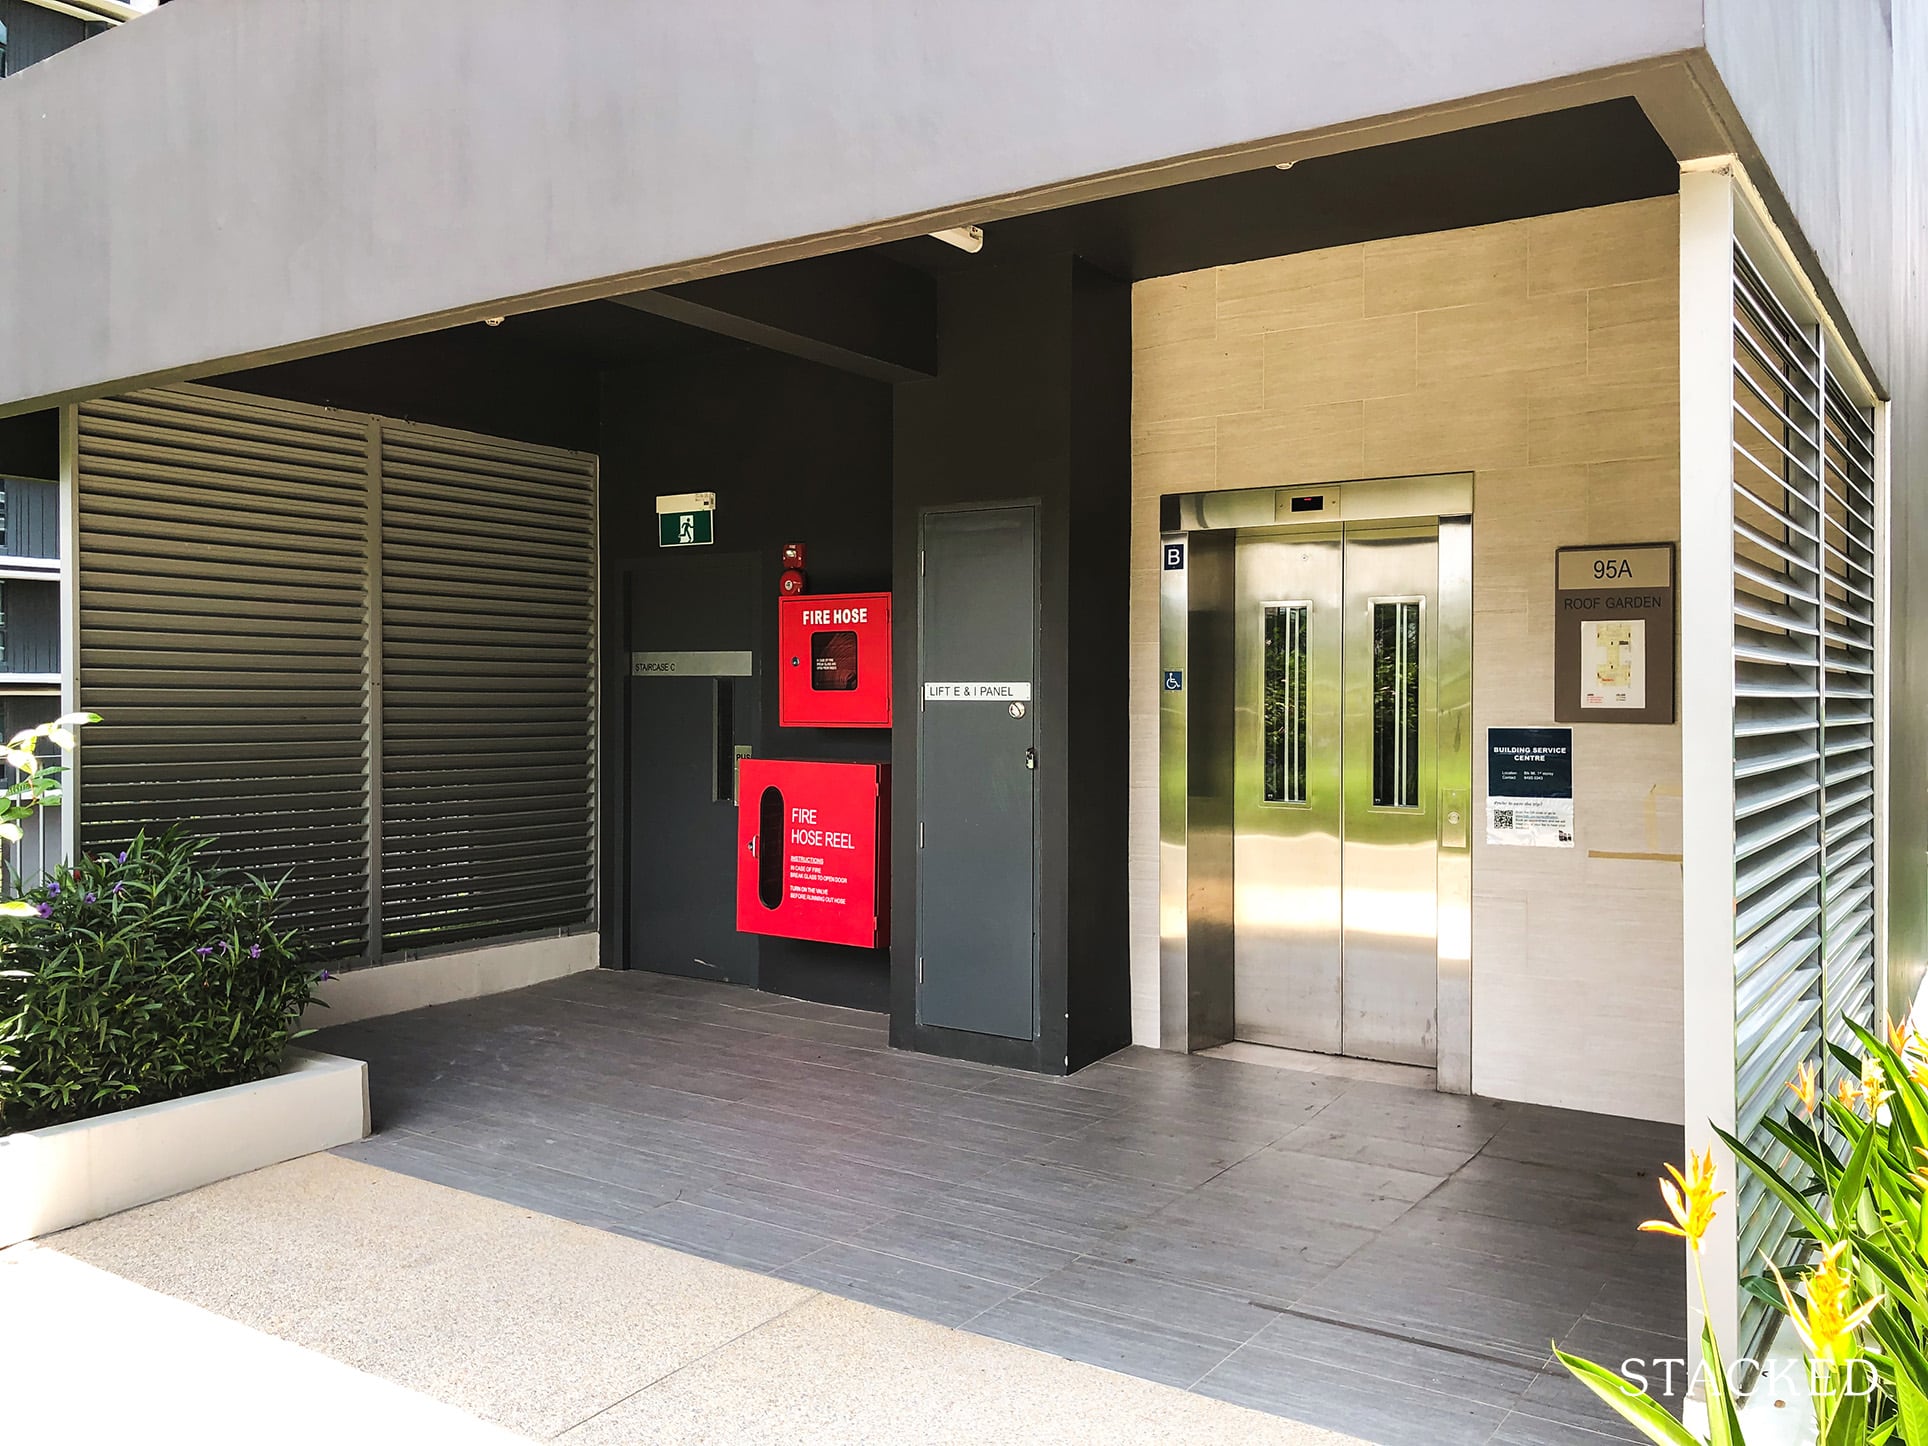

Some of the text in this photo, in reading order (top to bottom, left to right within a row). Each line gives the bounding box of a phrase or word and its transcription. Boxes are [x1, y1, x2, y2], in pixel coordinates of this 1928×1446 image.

[1167, 548, 1181, 566] B
[1593, 559, 1633, 579] 95A
[1564, 596, 1661, 611] ROOF GARDEN
[803, 608, 868, 625] FIRE HOSE
[635, 663, 676, 672] STAIRCASE C
[929, 686, 951, 697] LIFT
[953, 686, 961, 697] E
[963, 686, 971, 697] &
[980, 686, 1014, 697] PANEL
[791, 807, 817, 825] FIRE
[791, 829, 856, 849] HOSE REEL
[790, 855, 824, 865] INSTRUCTIONS
